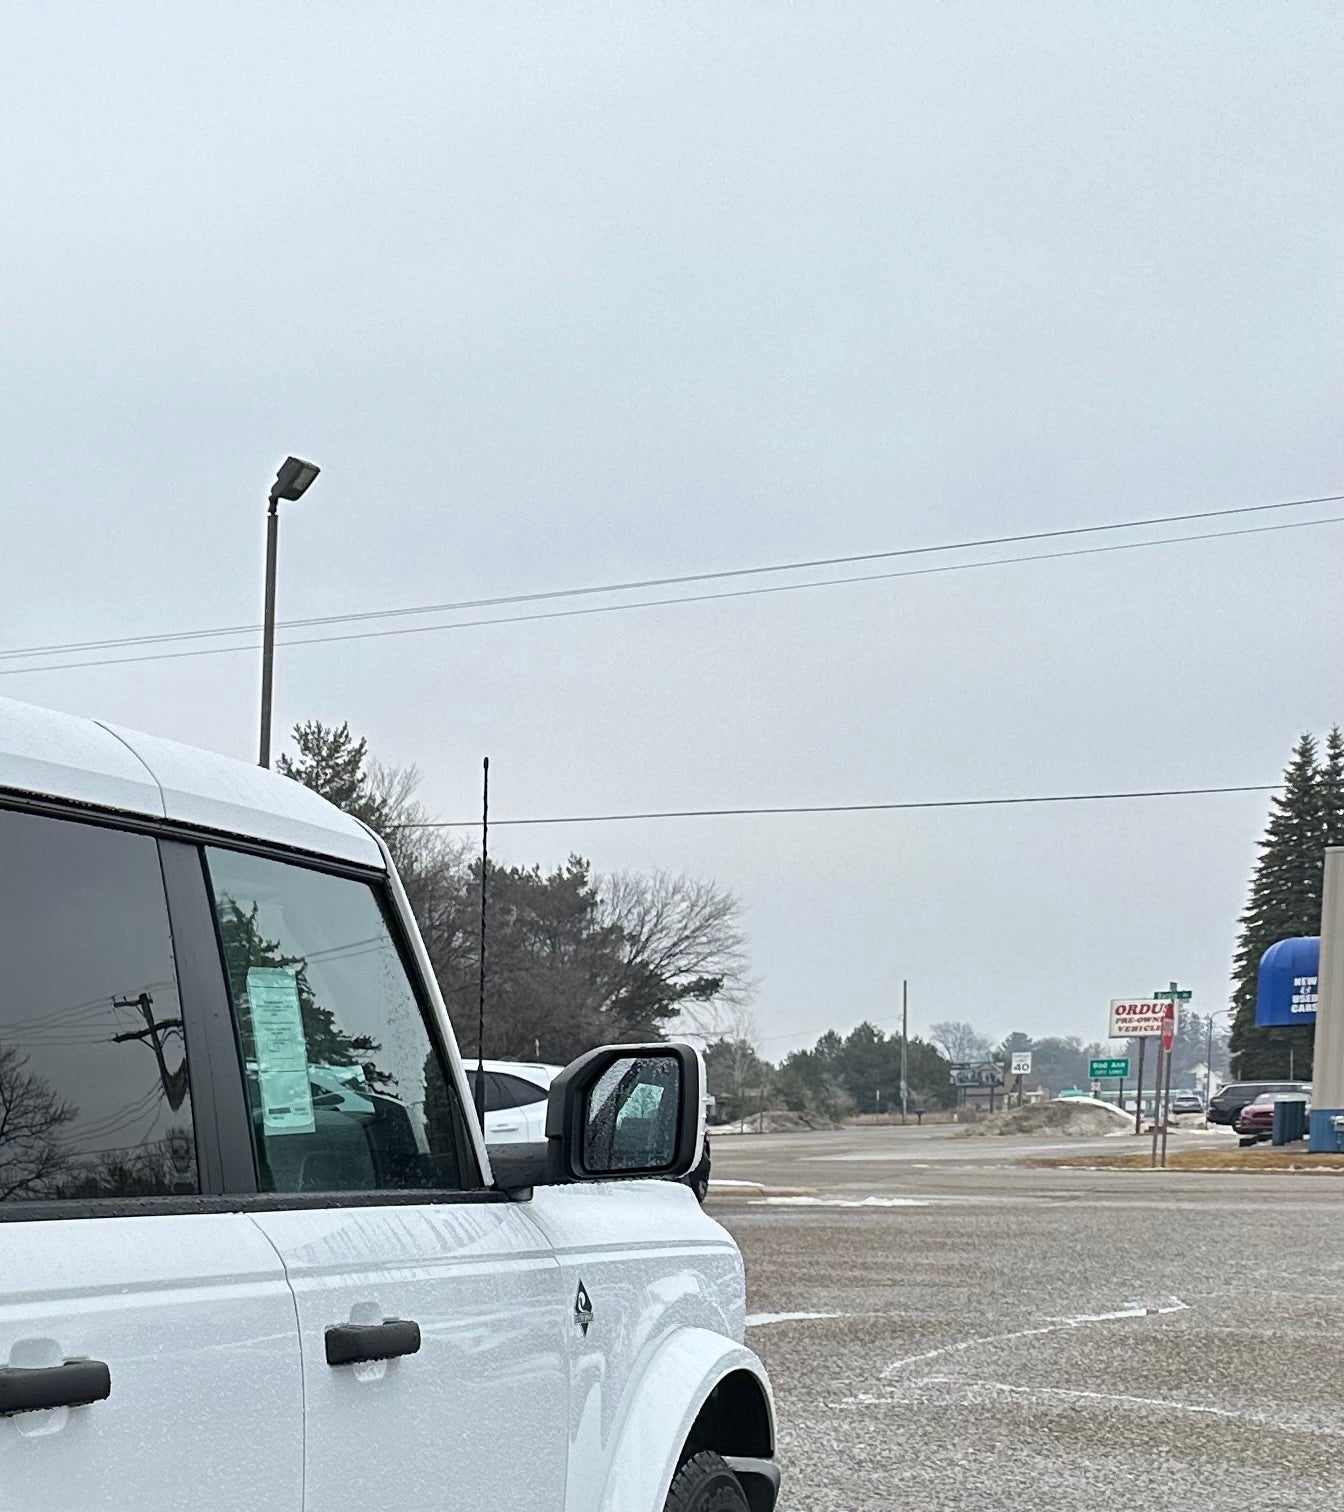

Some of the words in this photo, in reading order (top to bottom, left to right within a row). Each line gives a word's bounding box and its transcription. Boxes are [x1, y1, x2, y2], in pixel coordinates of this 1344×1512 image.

[1294, 976, 1318, 986] NEW
[1292, 994, 1318, 1003] USED
[1115, 1016, 1163, 1024] PRE-OWN
[1013, 1063, 1030, 1072] 40
